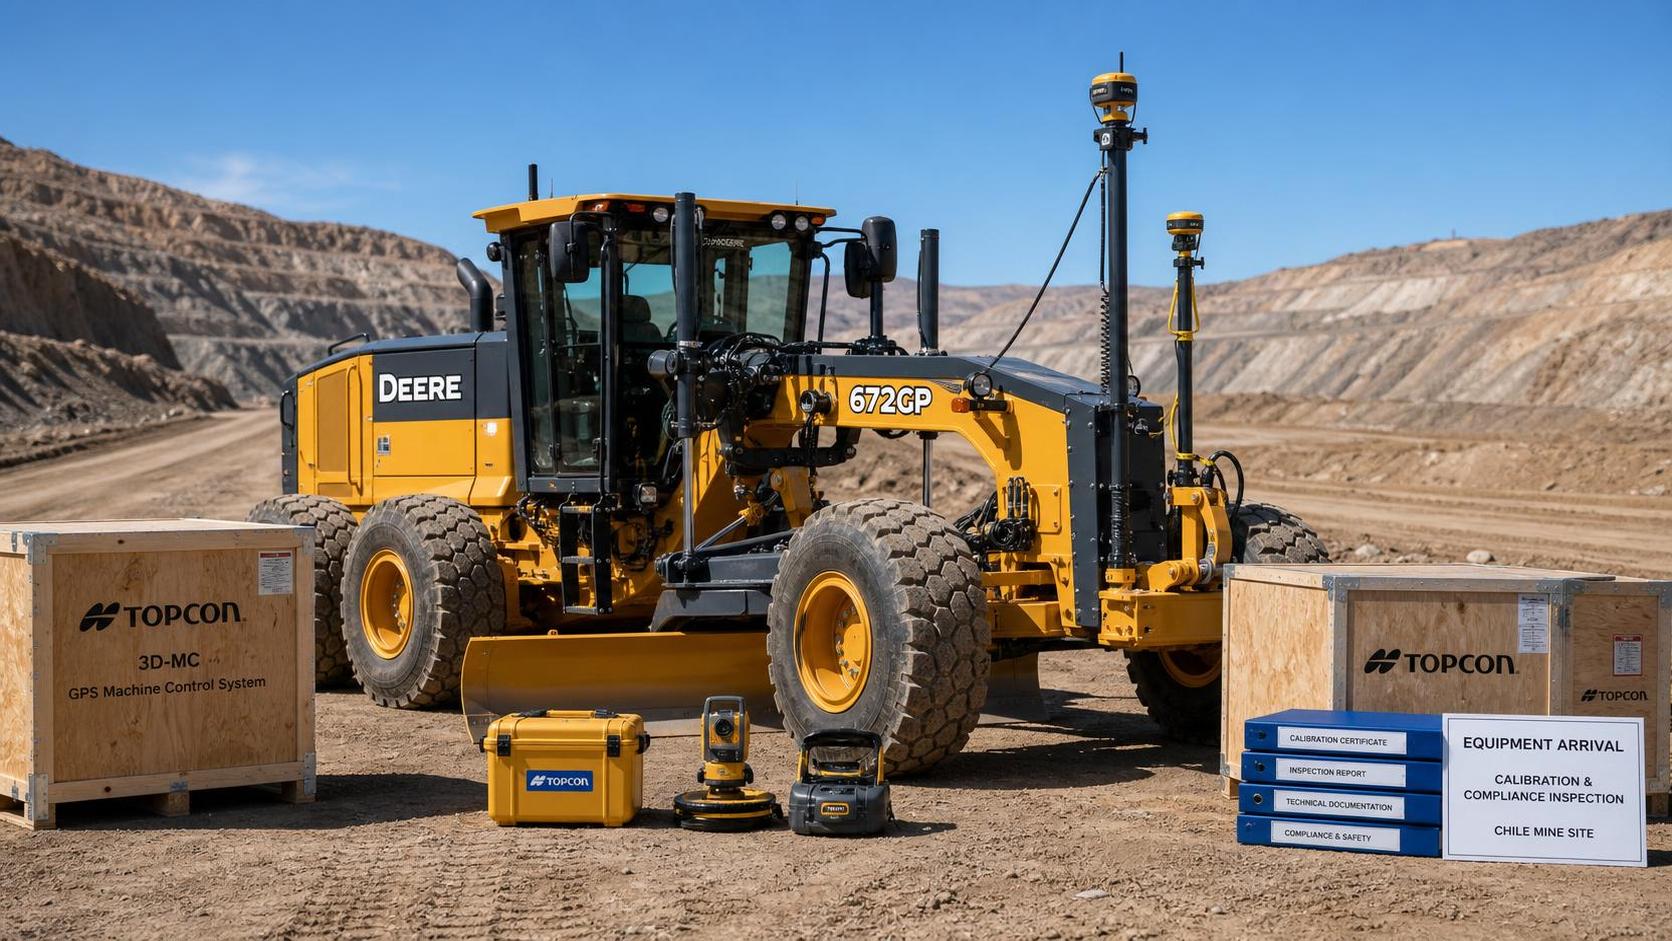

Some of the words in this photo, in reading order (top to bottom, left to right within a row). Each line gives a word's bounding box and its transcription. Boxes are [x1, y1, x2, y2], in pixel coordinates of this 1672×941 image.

[379, 373, 462, 402] DEERE
[848, 385, 932, 414] 672GP
[123, 602, 241, 628] TOPCON
[138, 652, 200, 671] 3D-MC
[1404, 653, 1515, 675] TOPCON
[68, 686, 99, 700] GPS
[103, 683, 161, 698] Machine
[164, 679, 214, 694] Control
[218, 677, 266, 692] System
[1599, 690, 1649, 701] TOPCON
[1289, 734, 1339, 744] CALIBRATION
[1339, 737, 1388, 747] CERTIFICATE
[1463, 736, 1553, 751] EQUIPMENT
[1557, 739, 1625, 752] ARRIVAL
[1289, 766, 1335, 776] INSPECTION
[1336, 769, 1367, 778] REPORT
[546, 777, 589, 786] TOPCON
[1494, 774, 1580, 787] CALIBRATION
[1583, 776, 1593, 787] &
[1463, 789, 1546, 803] COMPLIANCE
[1549, 792, 1625, 804] INSPECTION
[1286, 797, 1328, 808] TECHNICAL
[1328, 801, 1393, 811] DOCUMENTATION
[1284, 829, 1333, 840] COMPLIANCE
[1334, 832, 1341, 840] &
[1342, 833, 1372, 842] SAFETY
[1494, 825, 1530, 837] CHILE
[1533, 827, 1565, 838] MINE
[1567, 828, 1595, 839] SITE
